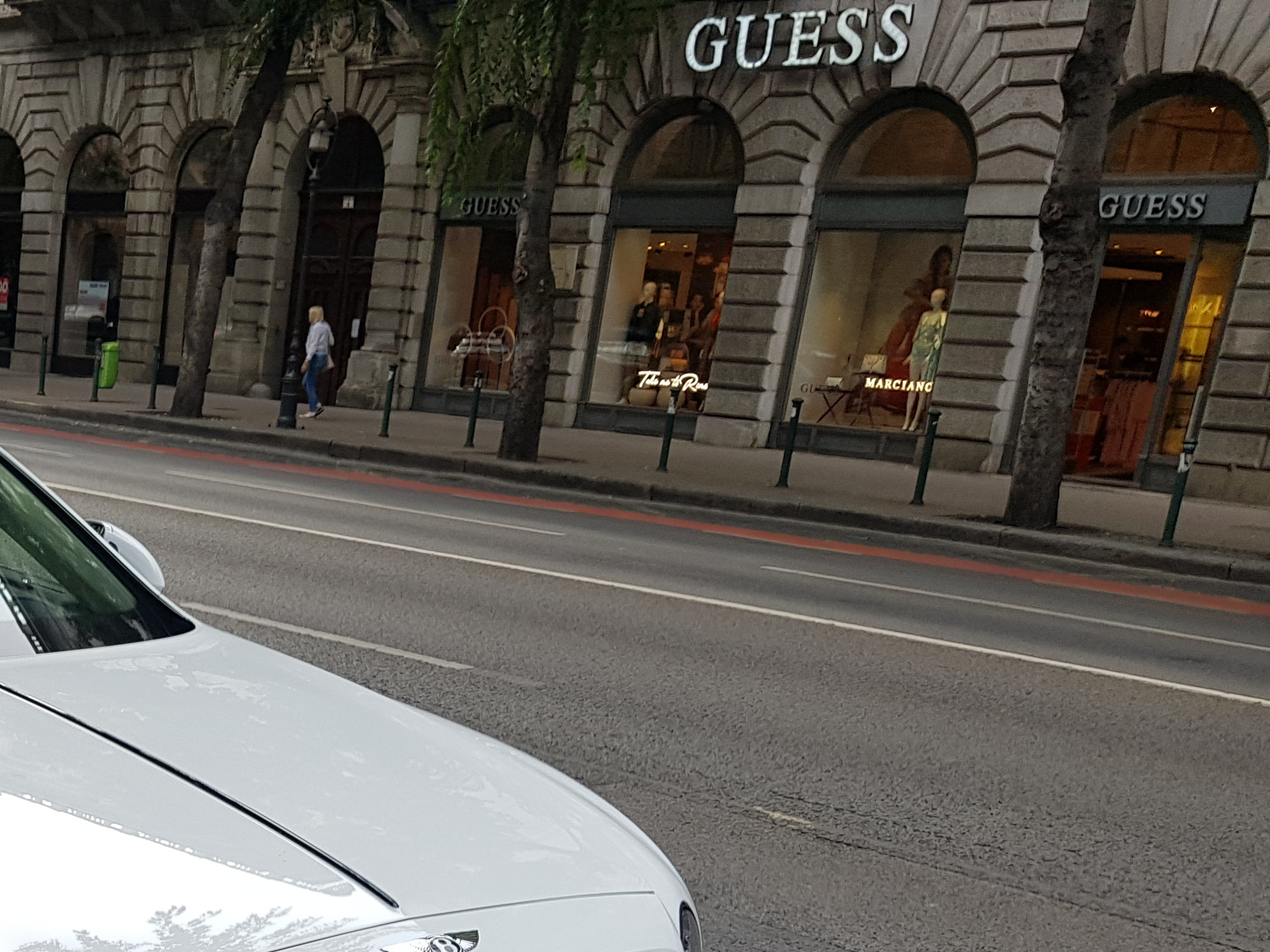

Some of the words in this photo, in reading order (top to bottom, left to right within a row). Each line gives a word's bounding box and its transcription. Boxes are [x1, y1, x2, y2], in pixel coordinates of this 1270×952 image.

[685, 3, 915, 72] GUESS
[460, 196, 521, 216] GUESS
[1098, 193, 1207, 219] GUESS
[864, 377, 934, 393] MARCIANO
